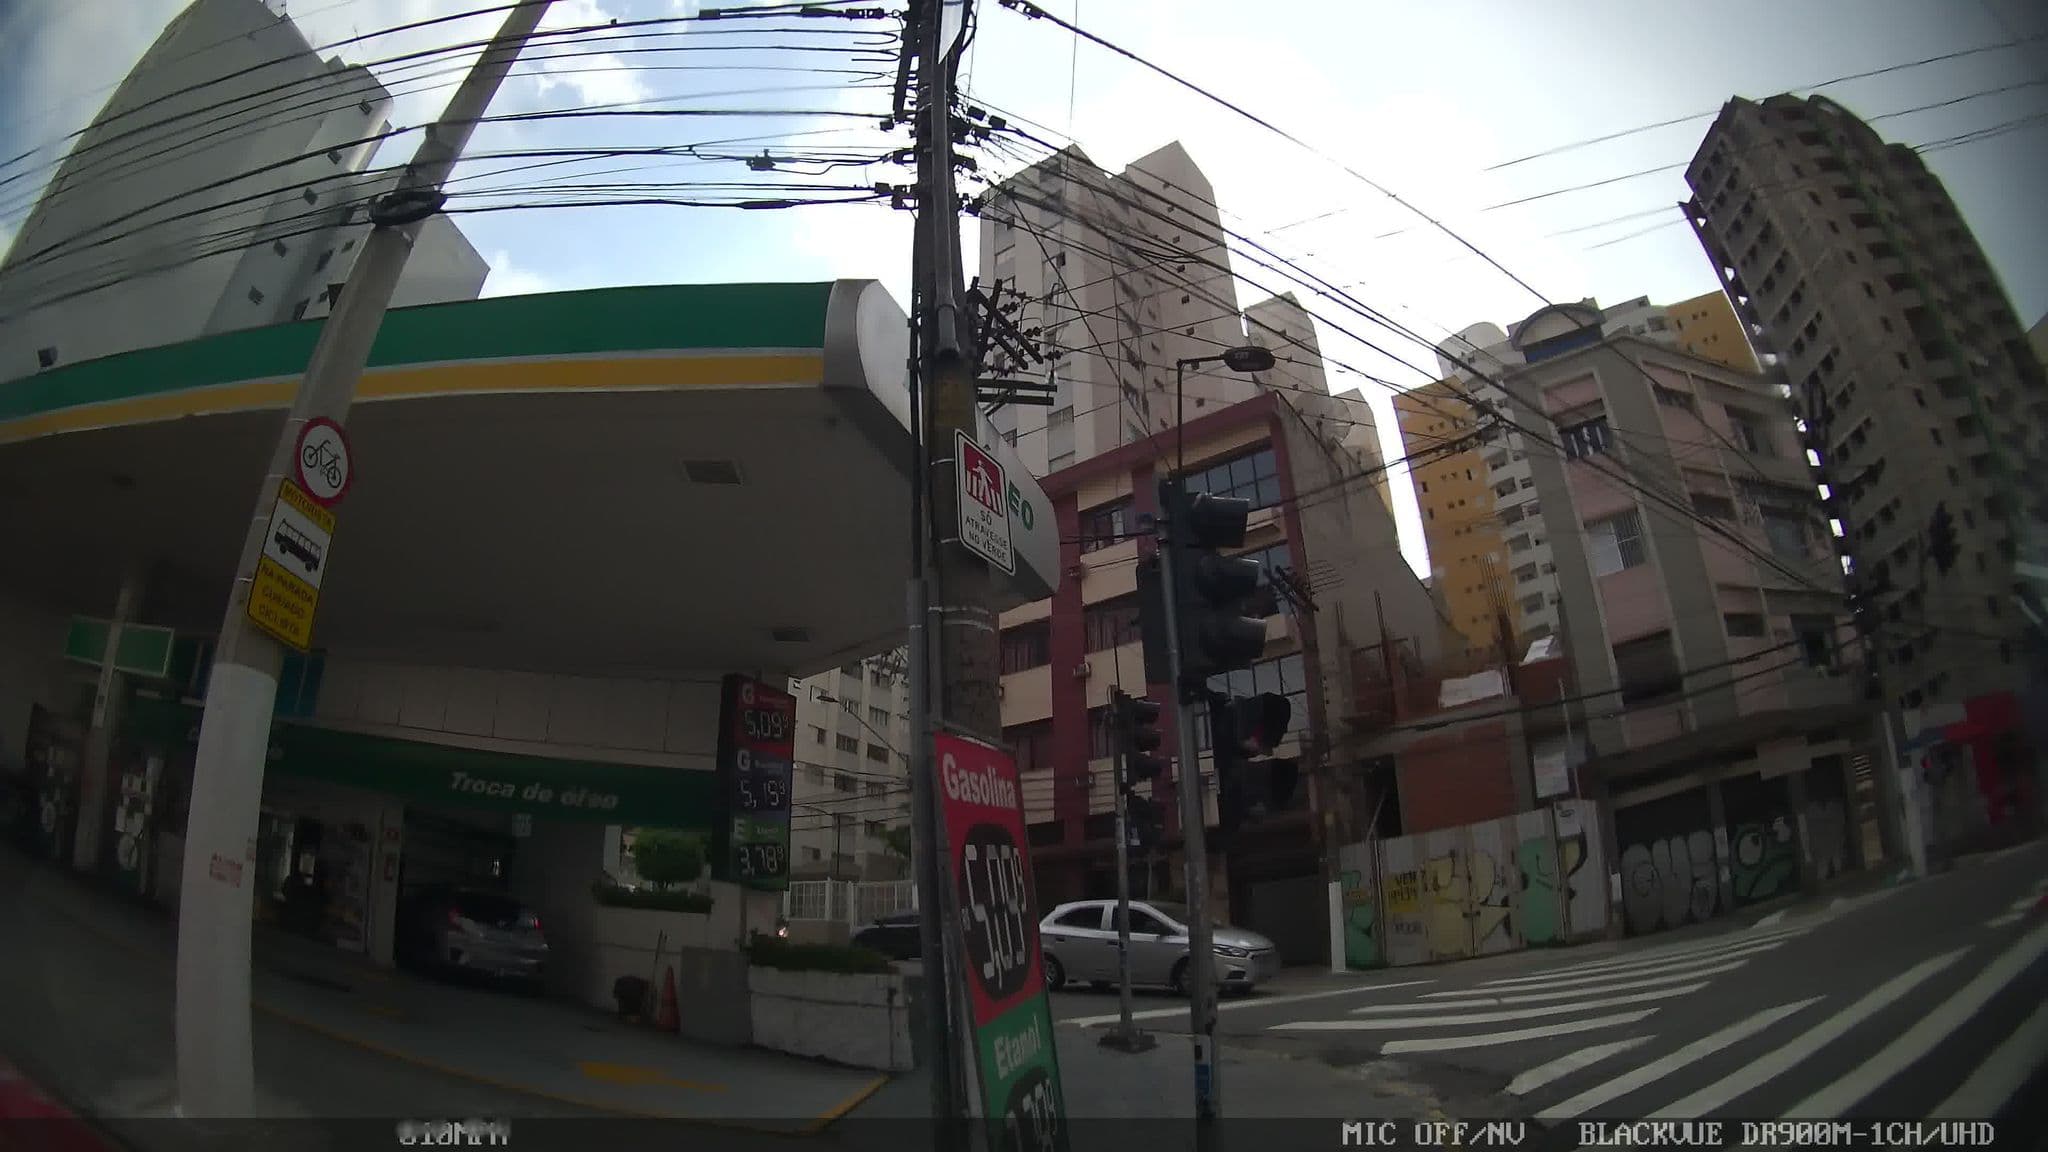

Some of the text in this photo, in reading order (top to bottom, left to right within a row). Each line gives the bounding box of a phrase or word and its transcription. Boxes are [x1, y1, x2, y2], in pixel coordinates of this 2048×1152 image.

[965, 516, 1008, 548] ATRAVESSE
[969, 530, 1007, 561] NO VERDE
[451, 771, 516, 798] Troca
[522, 782, 553, 803] de
[943, 752, 1018, 810] Gasolina
